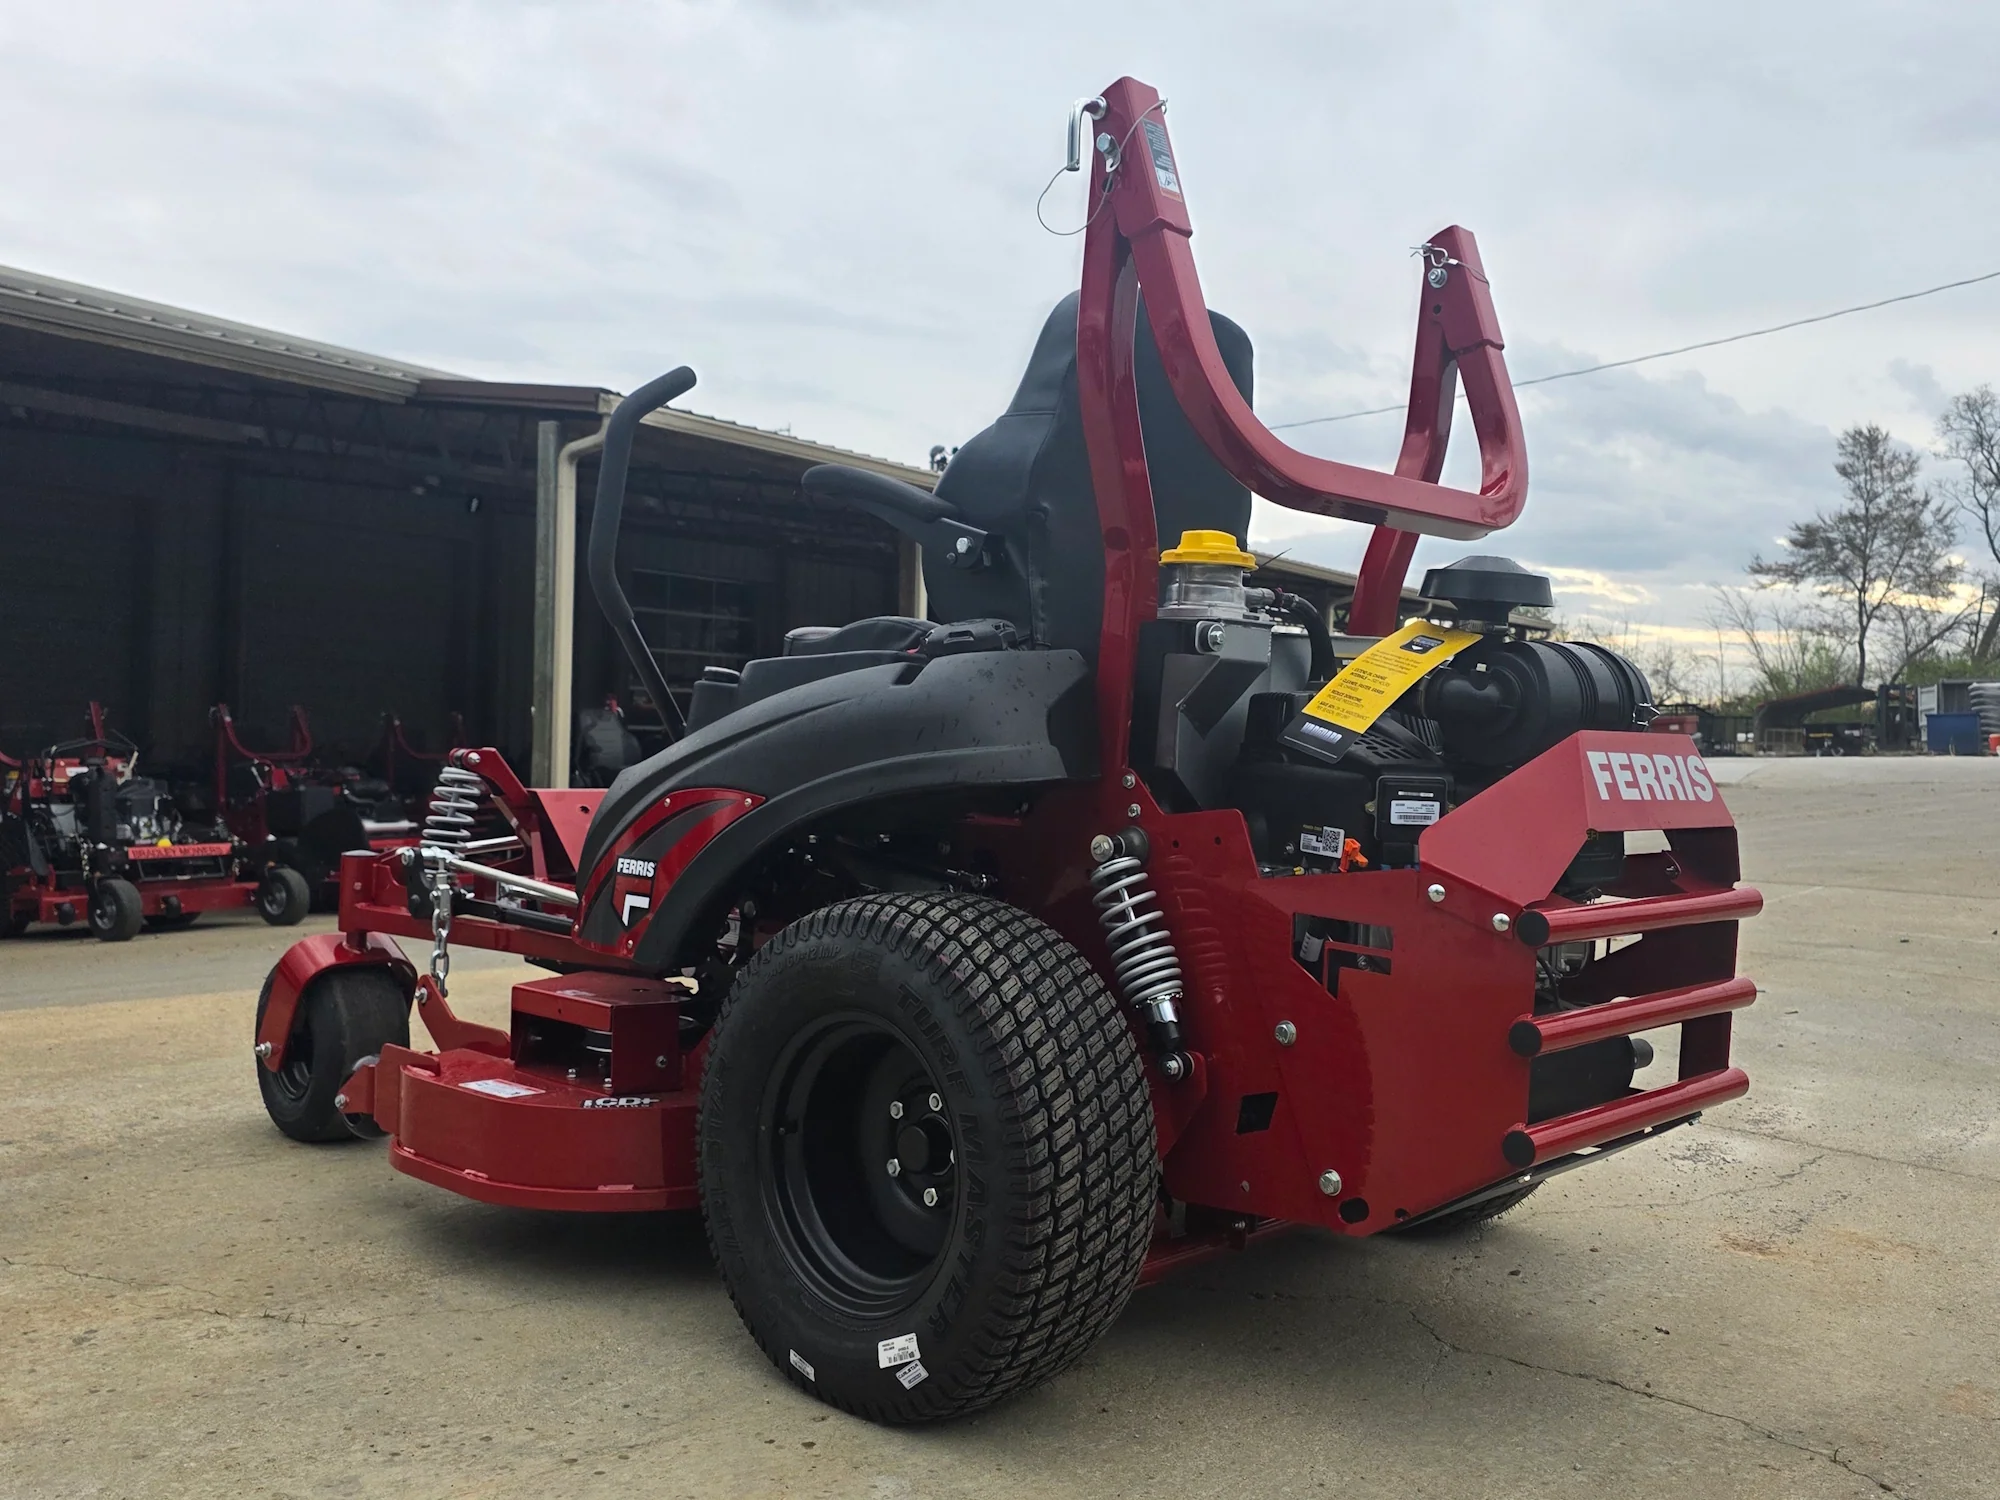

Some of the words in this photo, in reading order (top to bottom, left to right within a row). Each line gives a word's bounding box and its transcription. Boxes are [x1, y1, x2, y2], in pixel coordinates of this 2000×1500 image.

[1586, 751, 1714, 802] FERRIS
[132, 847, 176, 858] BRADLEY
[179, 846, 222, 856] MOWERS
[617, 858, 656, 878] FERRIS
[895, 981, 976, 1099] TURF
[926, 1111, 989, 1340] MASTER
